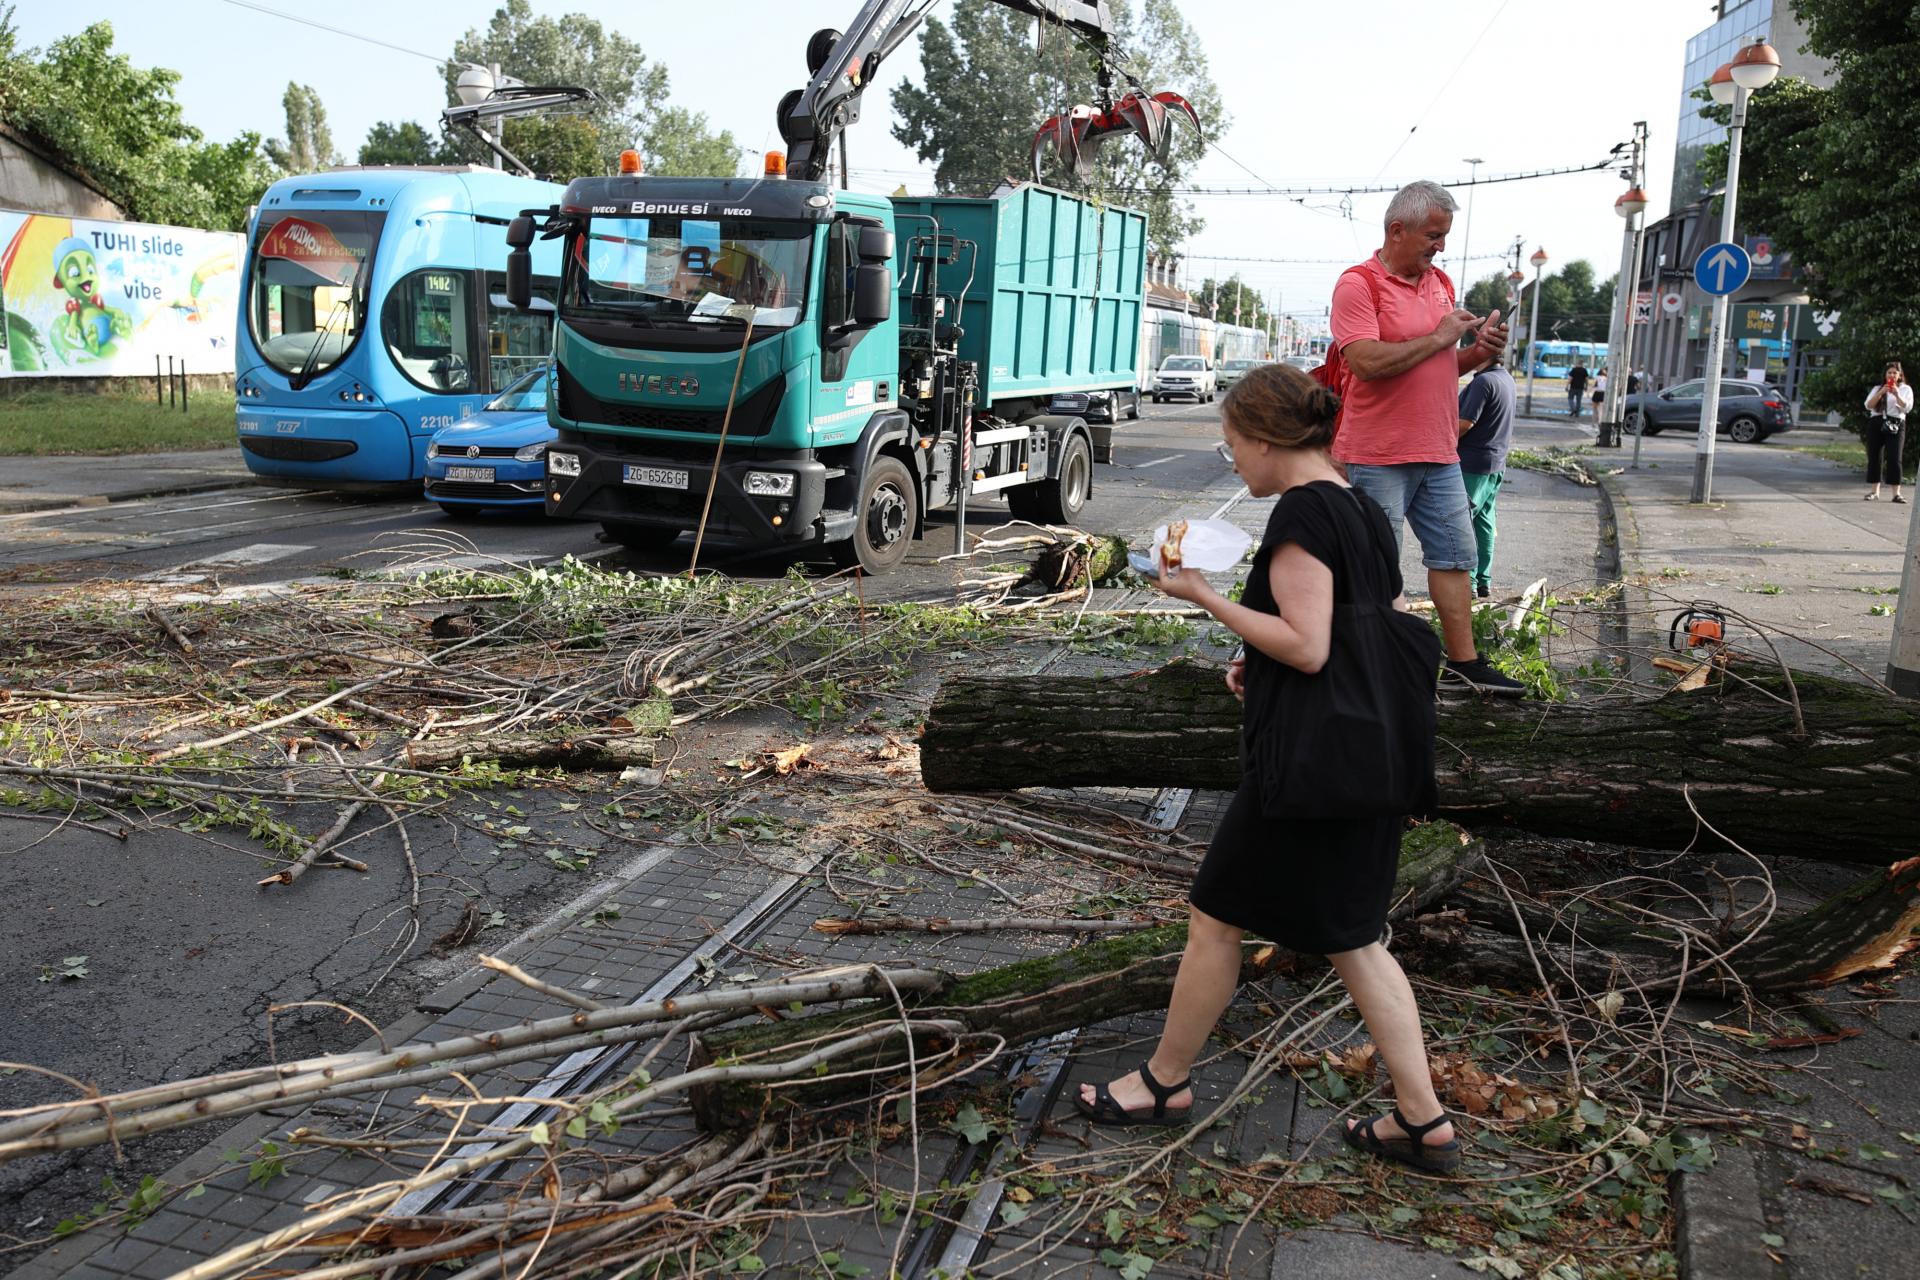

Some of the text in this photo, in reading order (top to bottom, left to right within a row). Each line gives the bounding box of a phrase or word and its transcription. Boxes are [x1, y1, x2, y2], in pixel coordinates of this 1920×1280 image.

[591, 206, 617, 214] IVECO
[631, 202, 709, 215] Benussi
[723, 208, 752, 216] IVECO
[91, 231, 184, 256] TUHI slide
[124, 279, 162, 300] vibe
[428, 275, 450, 291] 1402
[618, 373, 700, 397] IVECO
[421, 415, 454, 429] 22101
[630, 467, 643, 480] ZG
